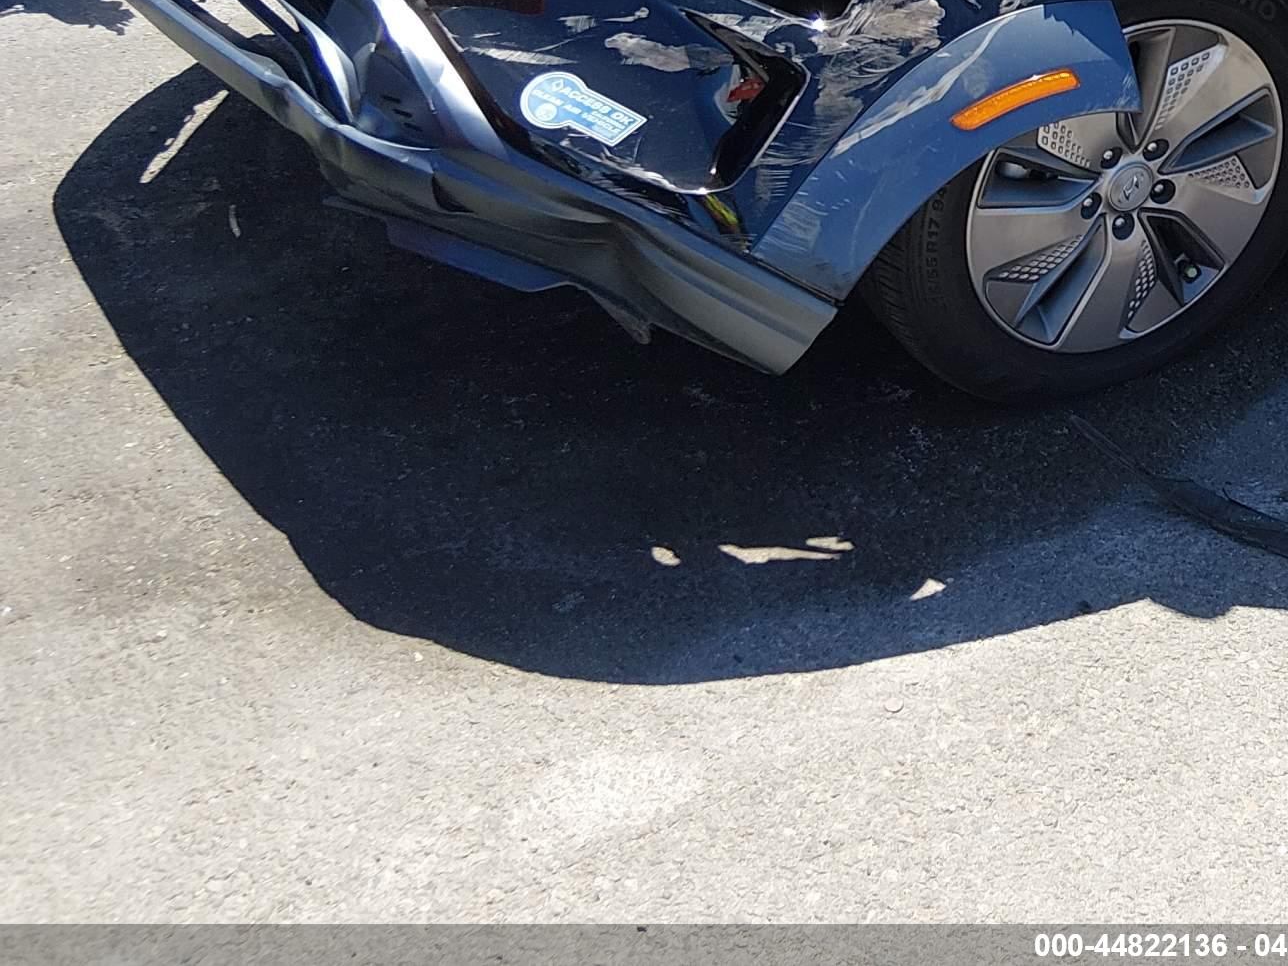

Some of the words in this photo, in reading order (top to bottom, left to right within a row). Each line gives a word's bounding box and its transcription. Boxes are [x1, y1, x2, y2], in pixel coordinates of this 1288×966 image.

[531, 89, 564, 107] CLEAN
[563, 104, 582, 115] AIR
[581, 111, 621, 132] VEHICLE
[559, 85, 612, 114] ACCESS
[611, 109, 634, 125] OK
